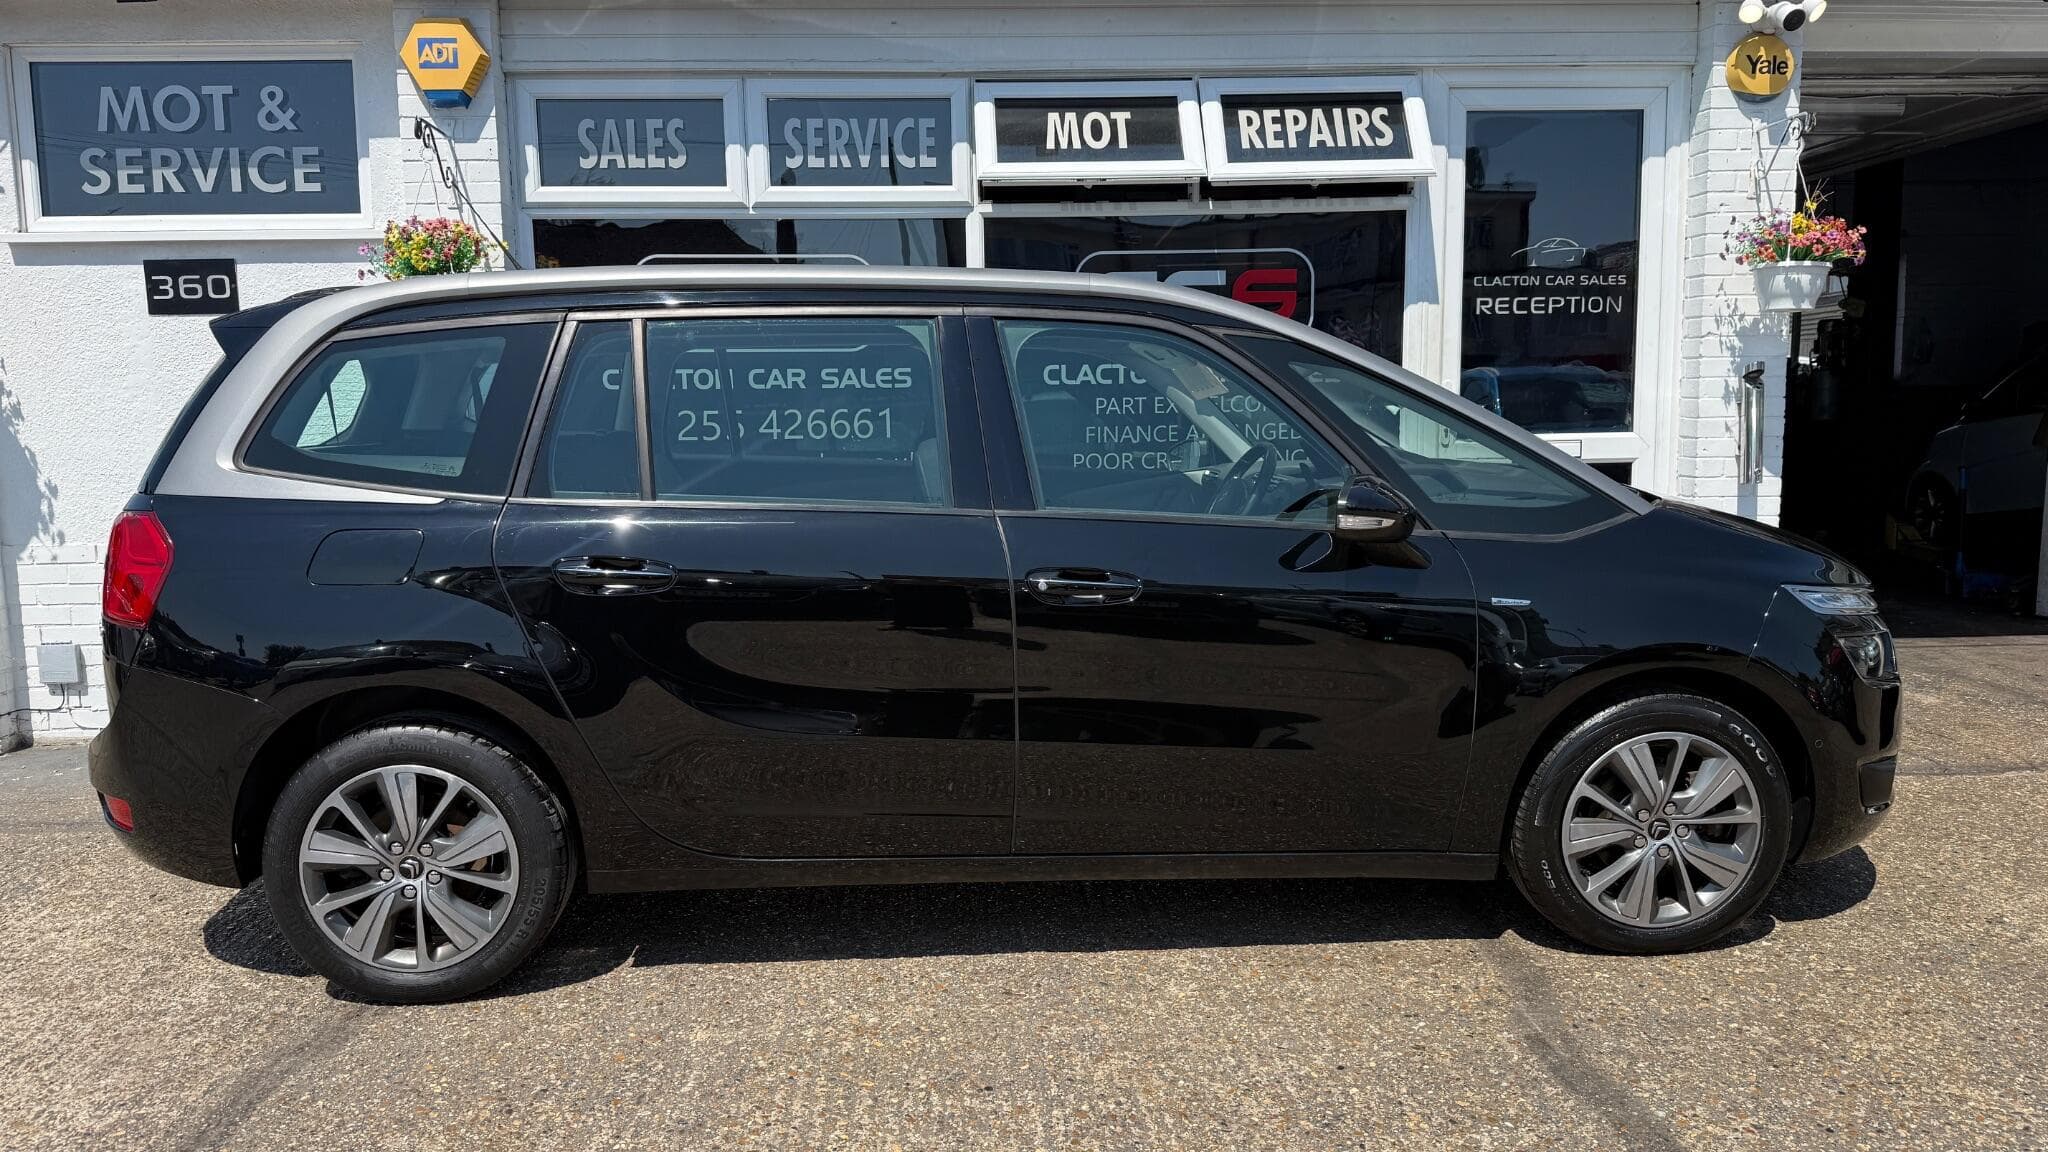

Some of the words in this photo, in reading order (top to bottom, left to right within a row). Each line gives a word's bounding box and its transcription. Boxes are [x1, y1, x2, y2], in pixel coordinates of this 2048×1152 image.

[419, 43, 457, 64] ADT
[1745, 55, 1788, 75] Yale
[98, 84, 233, 132] MOT
[256, 85, 298, 131] &
[1046, 111, 1131, 150] MOT
[1238, 107, 1394, 149] REPAIRS
[577, 118, 687, 169] SALES
[784, 117, 936, 169] SERVICE
[80, 145, 322, 194] SERVICE
[151, 275, 231, 300] 360
[1473, 275, 1539, 287] CLACTON
[1545, 275, 1574, 286] CAR
[1579, 274, 1627, 286] SALES
[1475, 295, 1622, 315] RECEPTION
[748, 368, 806, 389] CAR
[820, 367, 912, 389] SALES
[1095, 397, 1147, 415] PART
[758, 407, 891, 440] 426661
[1086, 425, 1179, 443] FINANCE
[1073, 452, 1134, 470] POOR
